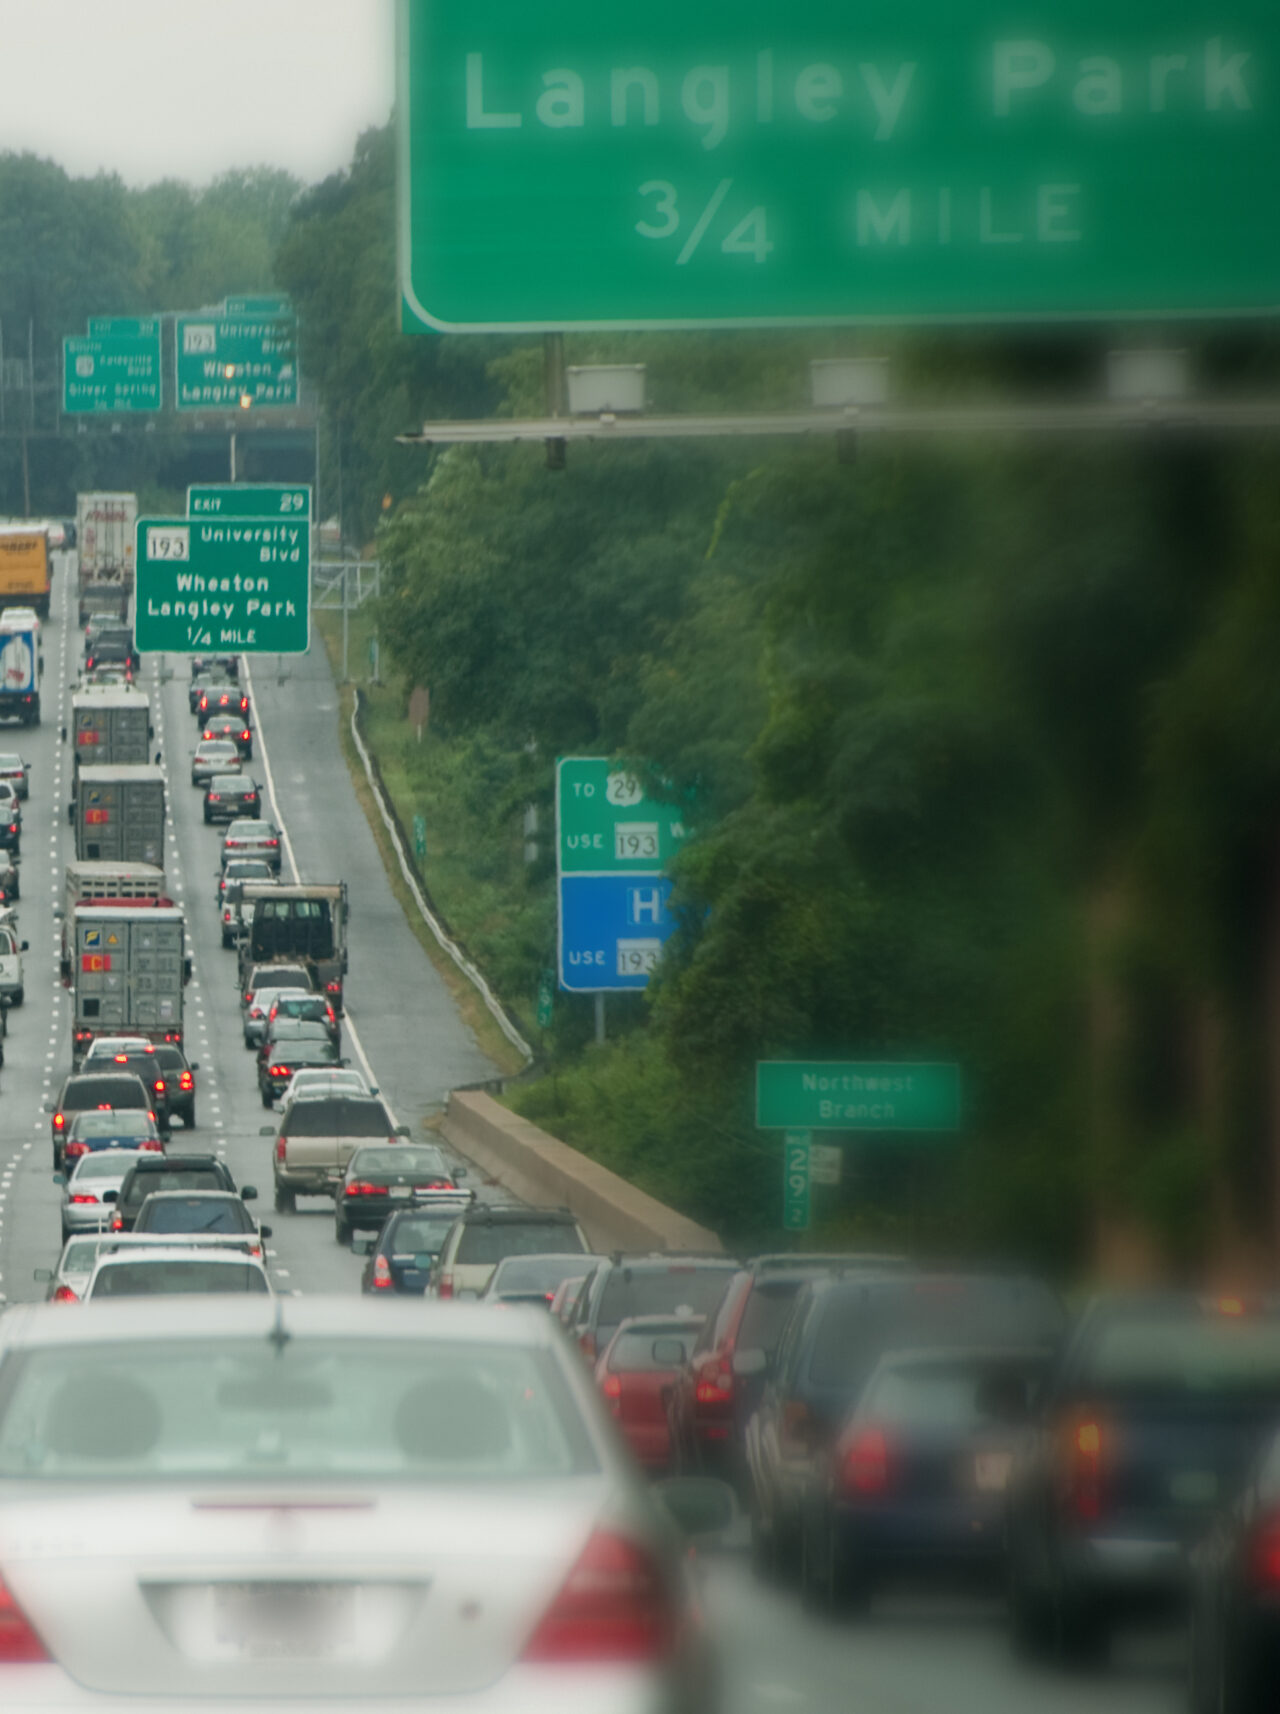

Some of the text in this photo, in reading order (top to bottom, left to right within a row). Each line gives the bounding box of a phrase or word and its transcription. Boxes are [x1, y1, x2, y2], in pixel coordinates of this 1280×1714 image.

[466, 36, 1254, 151] Langley Park
[634, 178, 1082, 265] 3/4 MILE
[204, 360, 272, 378] Whaton
[194, 493, 304, 513] EXIT 29
[152, 526, 299, 558] 193 University
[259, 546, 300, 562] Blvd
[176, 573, 269, 592] Wheaton
[148, 598, 296, 621] Langley Park
[187, 626, 257, 645] 1/4 MILE
[573, 778, 636, 800] TO 29
[567, 834, 656, 857] USE 193
[632, 889, 660, 924] H
[569, 951, 657, 973] USE 193
[802, 1073, 914, 1092] Northwest
[819, 1099, 895, 1119] Branch
[788, 1148, 807, 1198] 29
